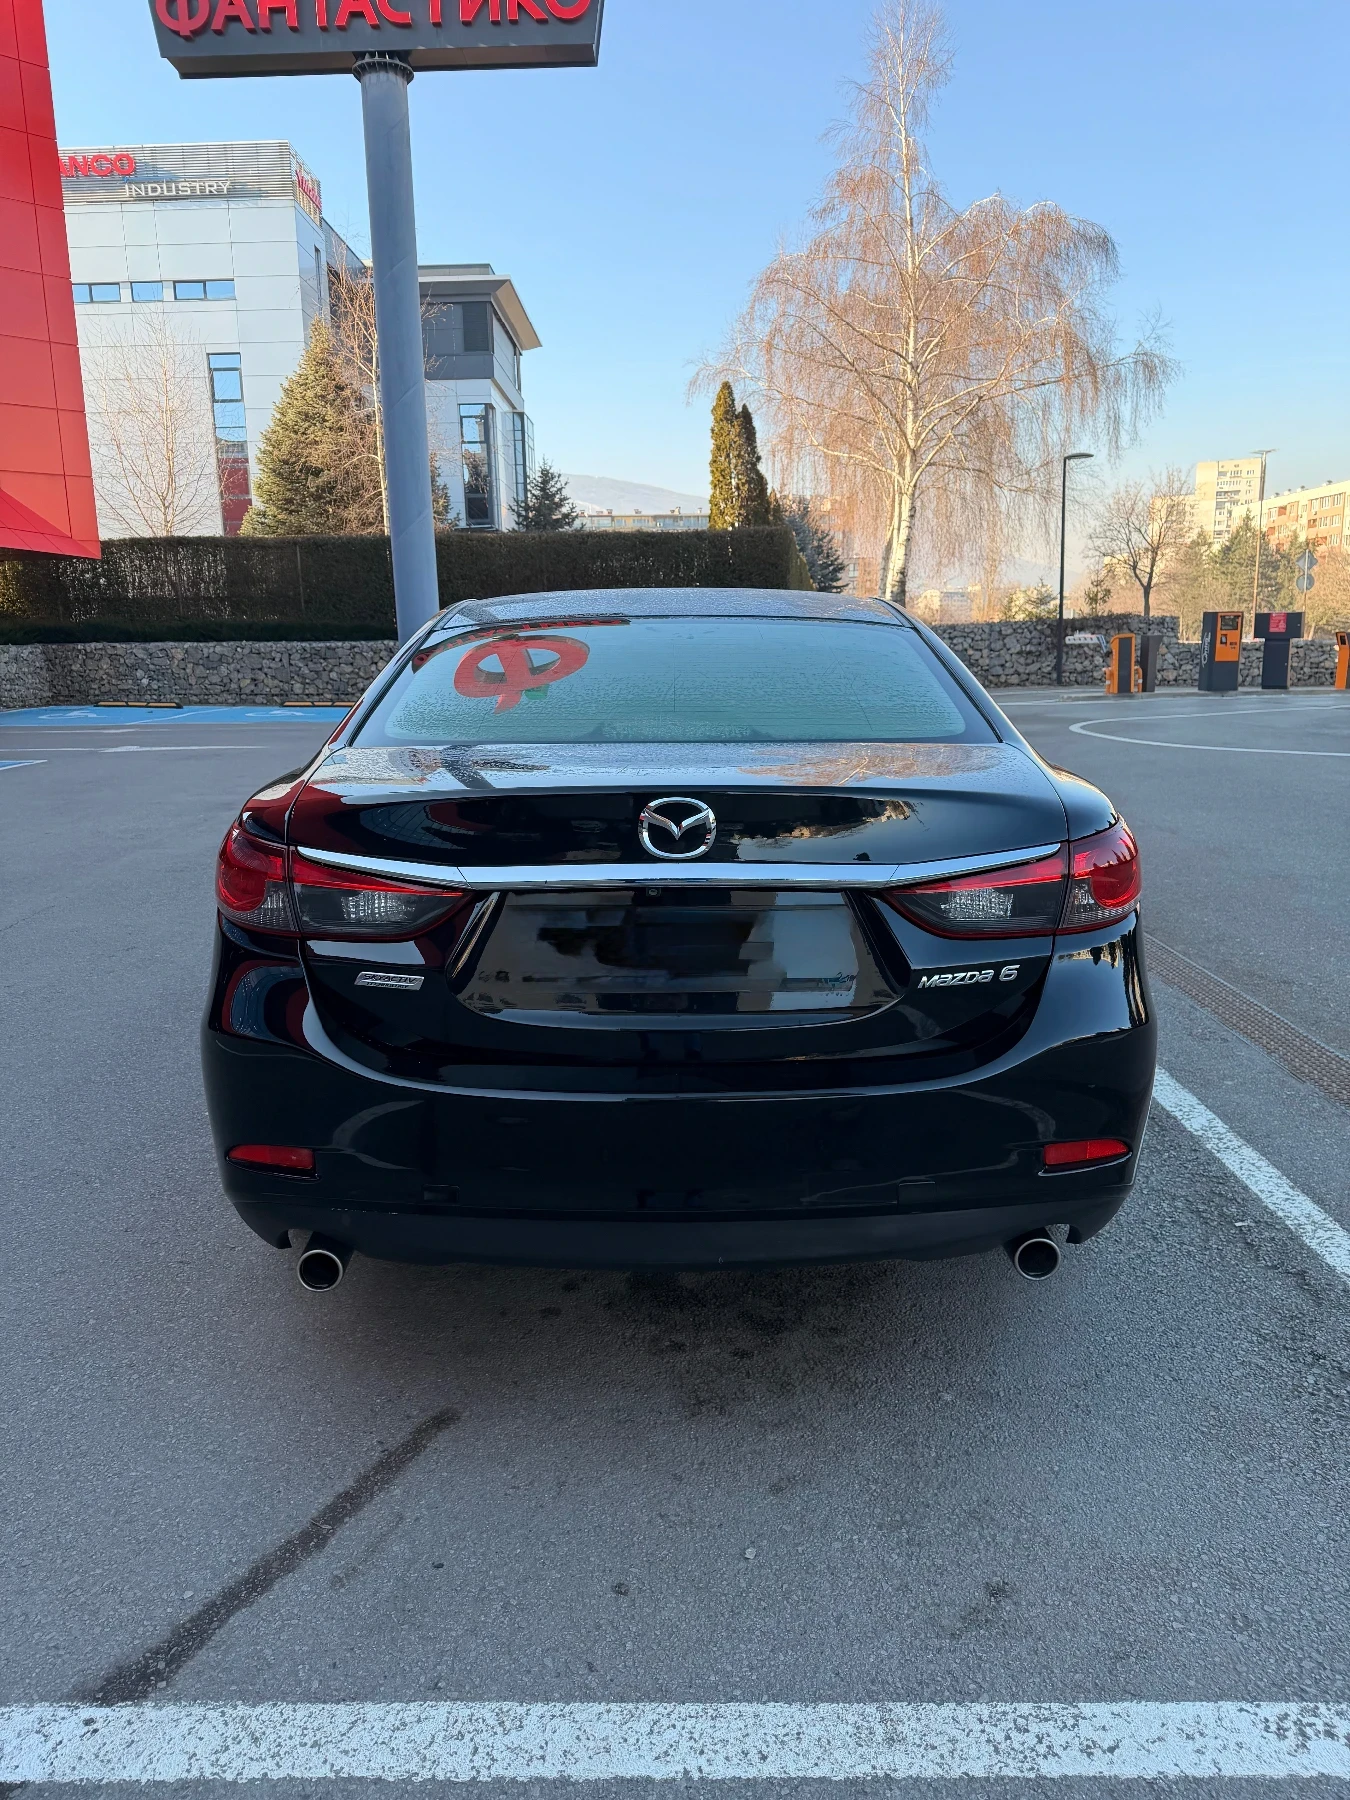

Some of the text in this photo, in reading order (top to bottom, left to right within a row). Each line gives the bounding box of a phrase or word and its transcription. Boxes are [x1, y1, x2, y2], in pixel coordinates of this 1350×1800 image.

[124, 180, 231, 198] INDUSTRY
[364, 973, 418, 984] SKYACTIV
[999, 964, 1021, 982] 6
